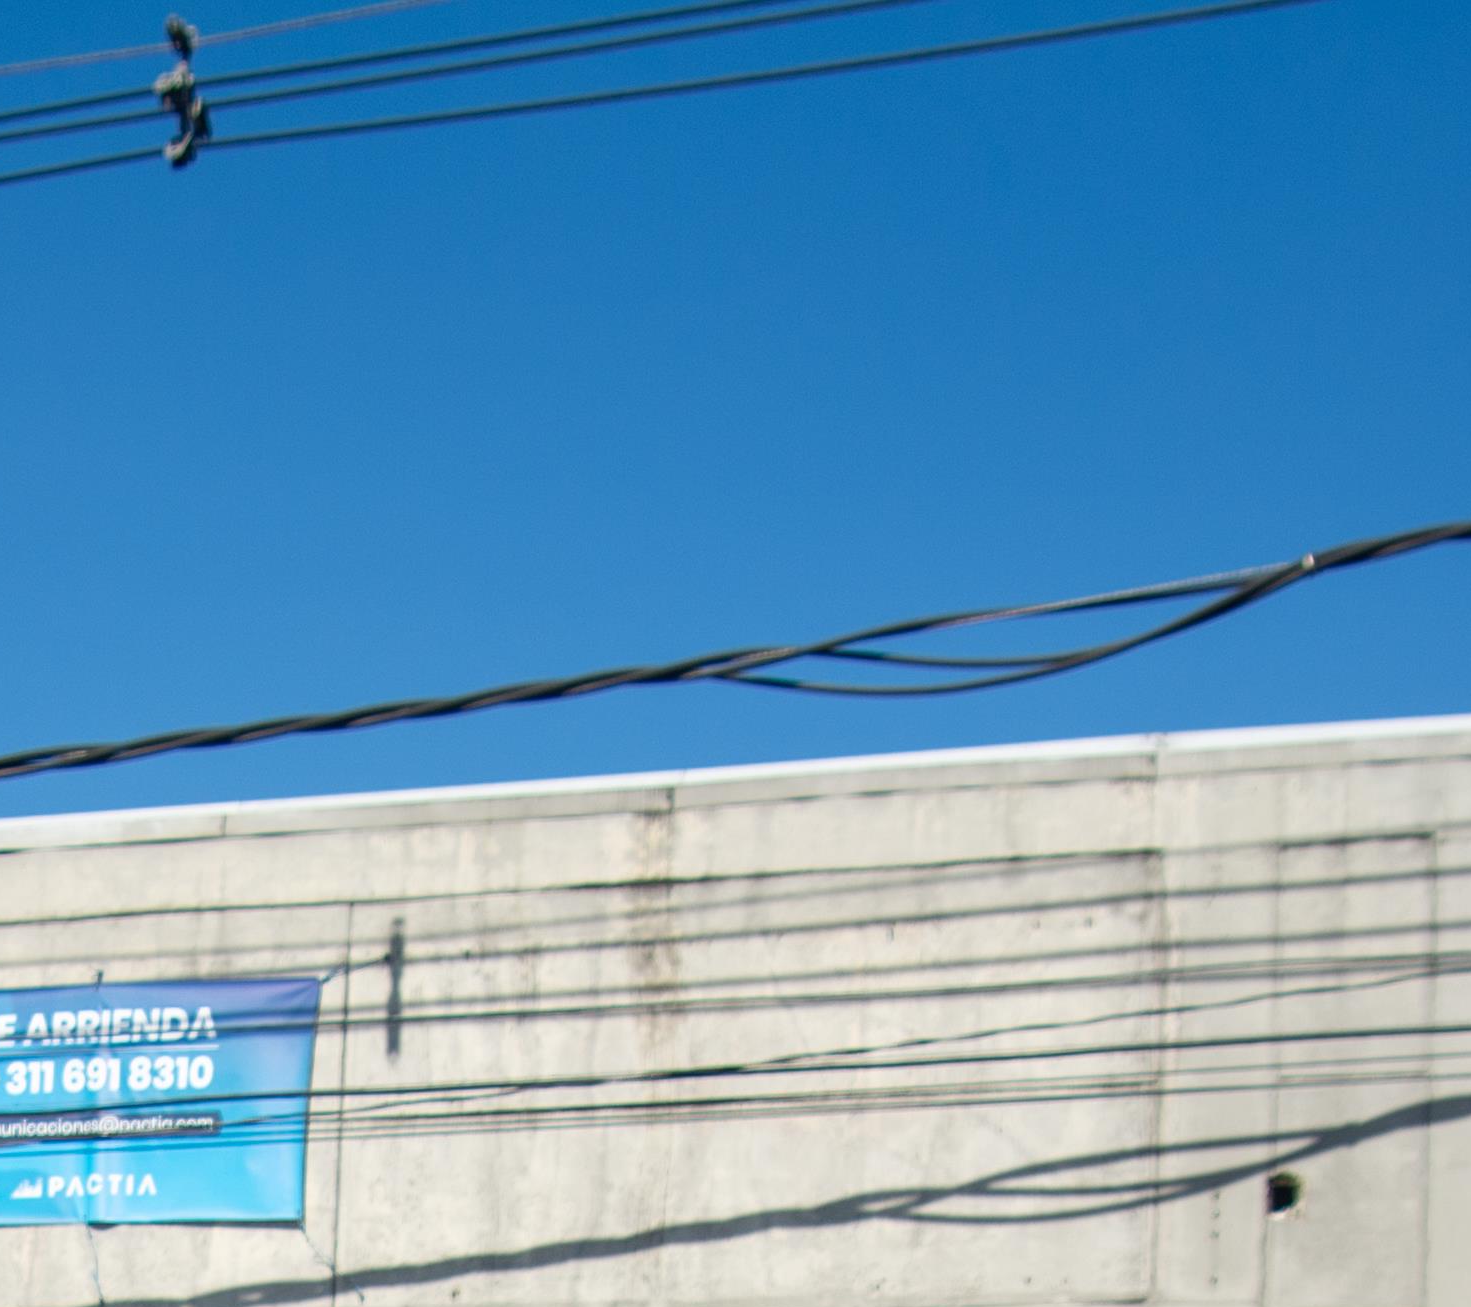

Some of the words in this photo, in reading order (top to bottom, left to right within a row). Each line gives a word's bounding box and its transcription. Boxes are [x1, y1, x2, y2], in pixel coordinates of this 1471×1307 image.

[23, 1007, 216, 1046] ARRIENDA
[5, 1059, 55, 1096] 311
[62, 1057, 121, 1094] 691
[128, 1055, 215, 1092] 8310
[47, 1173, 157, 1198] PACTIA
